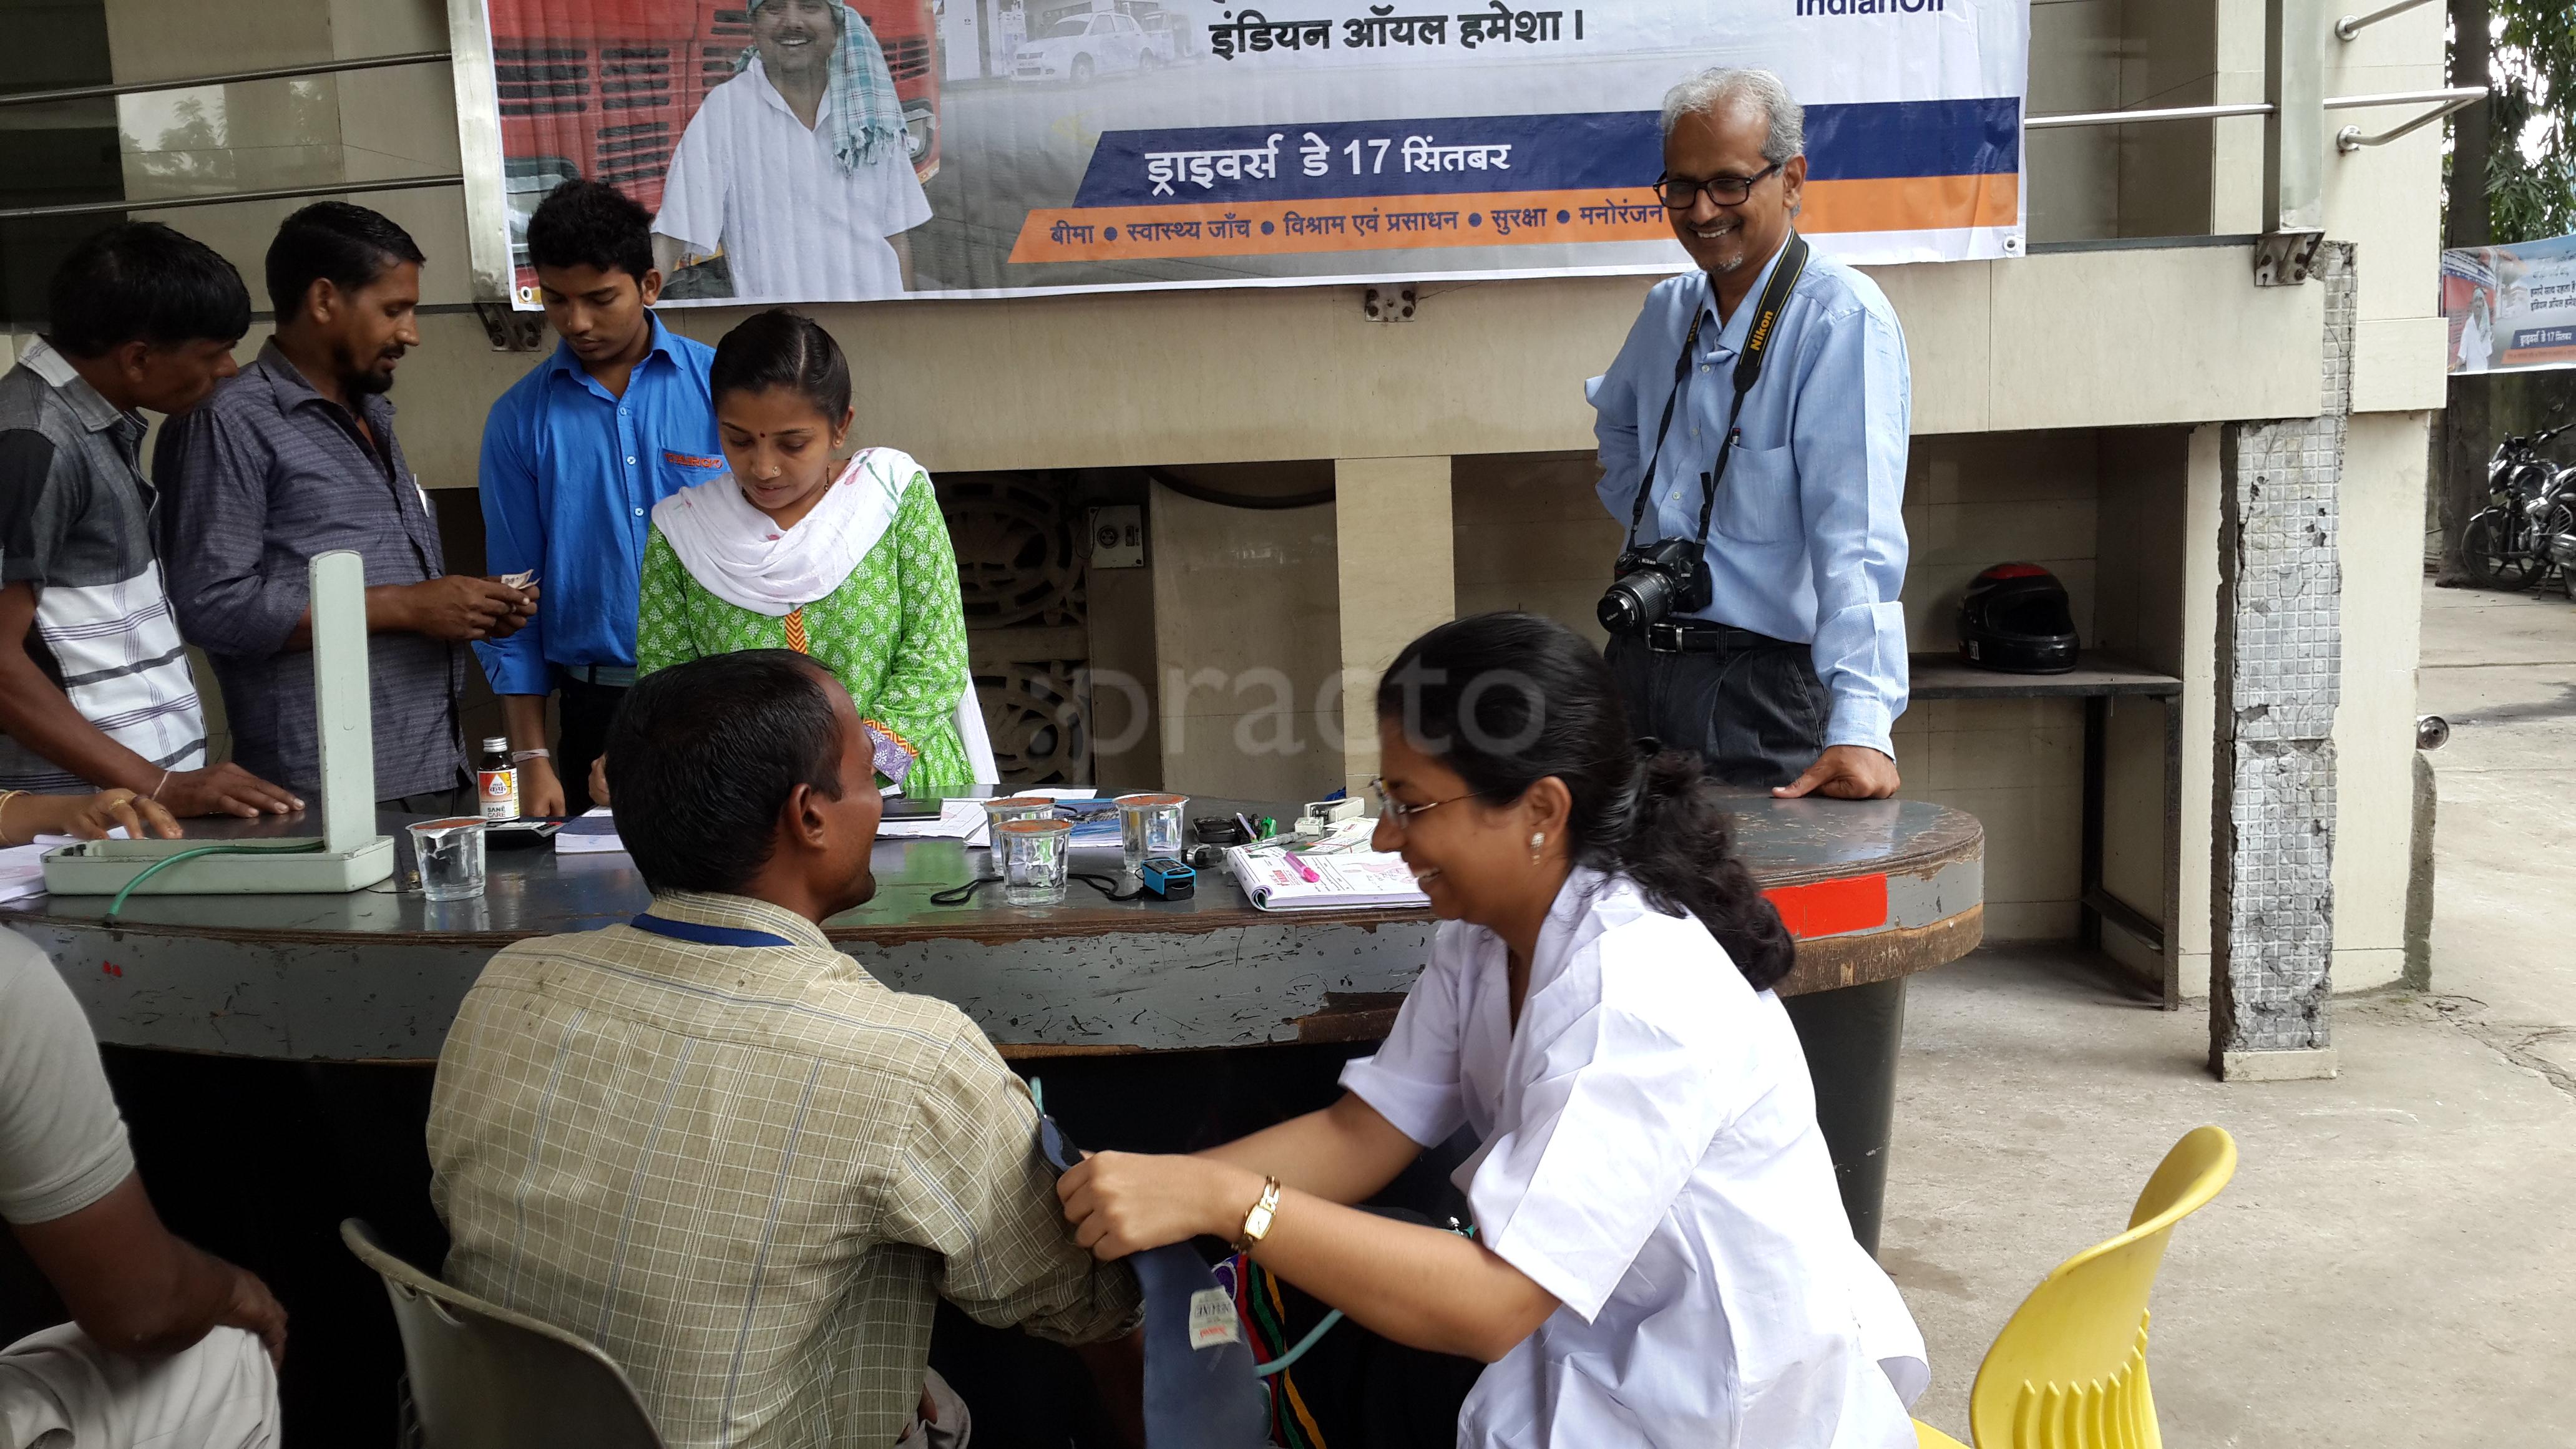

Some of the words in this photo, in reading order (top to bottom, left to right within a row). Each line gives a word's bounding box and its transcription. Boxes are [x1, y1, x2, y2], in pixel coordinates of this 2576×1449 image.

[1208, 9, 1332, 61] इंडियन
[1342, 4, 1448, 47] ऑयल
[1457, 0, 1563, 49] हमेशा
[1796, 0, 1944, 16] IndianOil
[1144, 133, 1283, 197] ड्राइवर्स
[1299, 132, 1330, 177] डे
[1344, 139, 1392, 175] 17
[1050, 218, 1094, 245] बीमा
[1126, 220, 1201, 243] स्वास्थ्य
[1207, 212, 1252, 240] जाँच
[1282, 210, 1345, 236] विश्राम
[1351, 206, 1379, 237] एवं
[1385, 210, 1459, 232] प्रसाधन
[1490, 208, 1548, 235] सुरक्षा
[1579, 198, 1664, 226] मनोरंजन
[1750, 311, 1773, 351] Nikon
